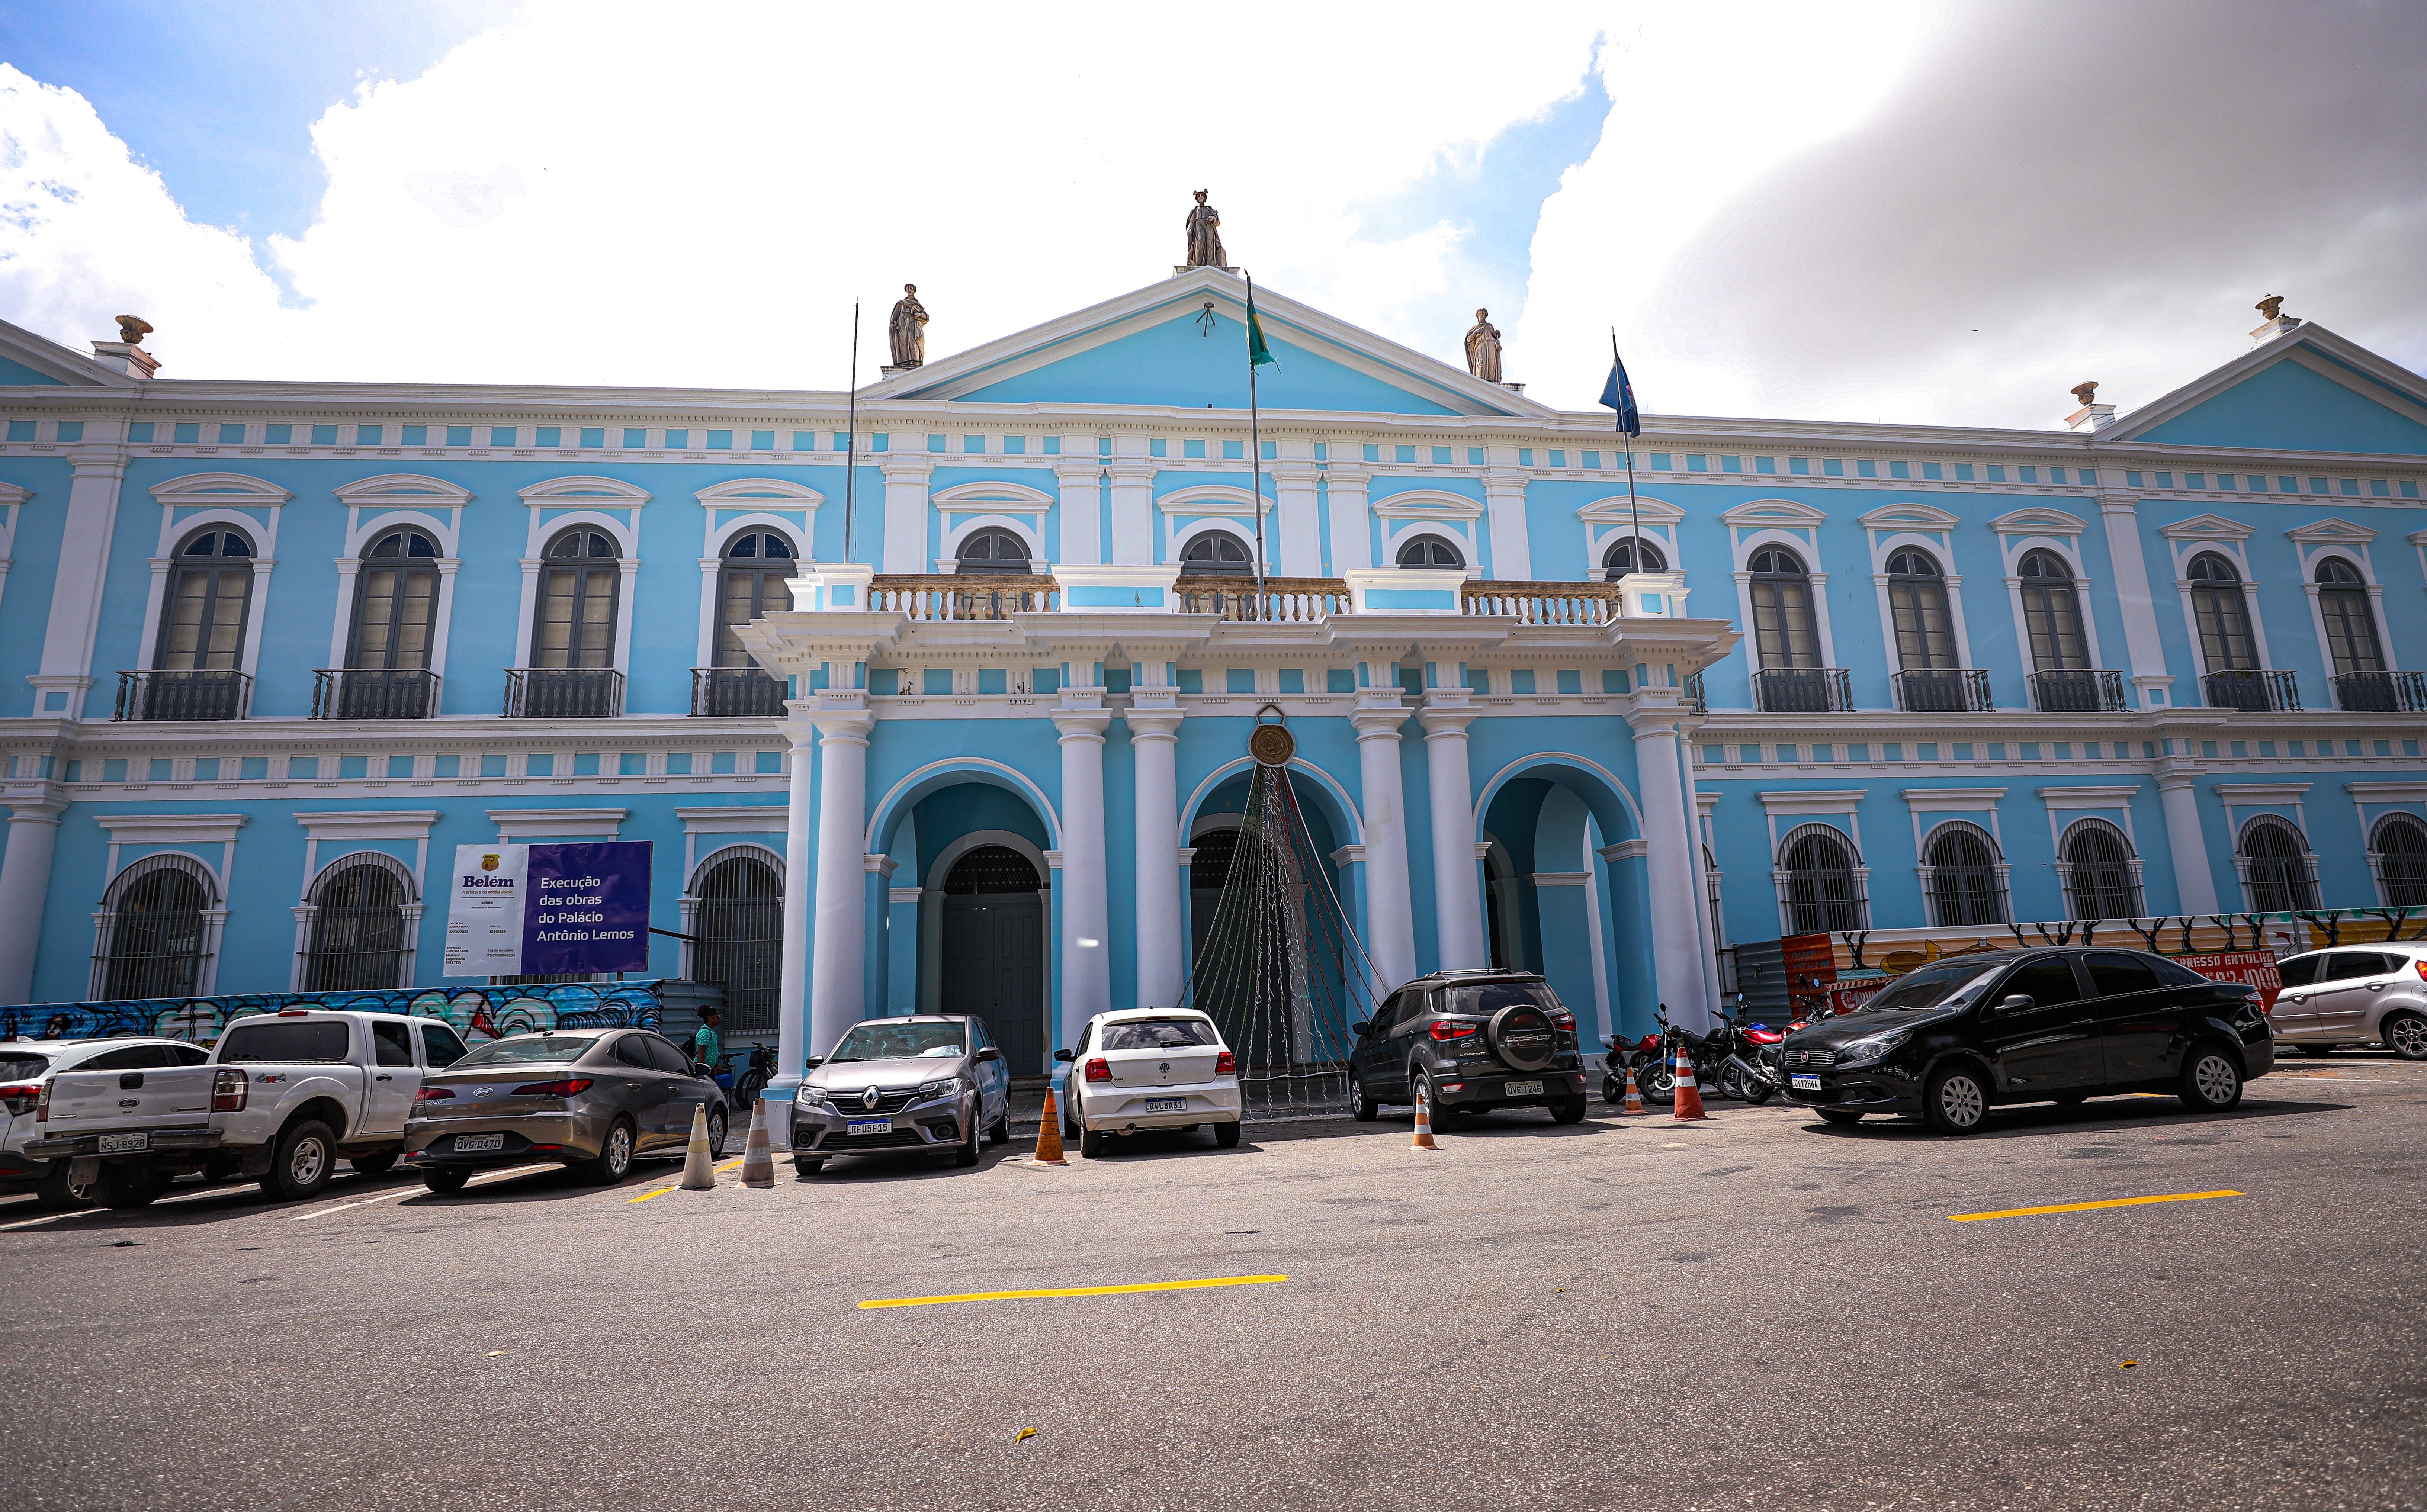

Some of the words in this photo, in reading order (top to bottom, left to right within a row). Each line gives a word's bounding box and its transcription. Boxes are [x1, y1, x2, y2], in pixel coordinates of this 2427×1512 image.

[462, 875, 514, 888] Belém
[541, 876, 600, 890] Execução
[540, 894, 563, 905] das
[566, 894, 602, 905] obras
[538, 913, 555, 923] do
[558, 911, 603, 923] Palácio
[536, 930, 589, 942] Antônio
[592, 929, 634, 940] Lemos
[2225, 953, 2273, 965] ENTULHO
[1795, 1079, 1818, 1088] QVY2H64
[1150, 1101, 1182, 1110] RWL8A31
[851, 1123, 887, 1134] RFU5F15
